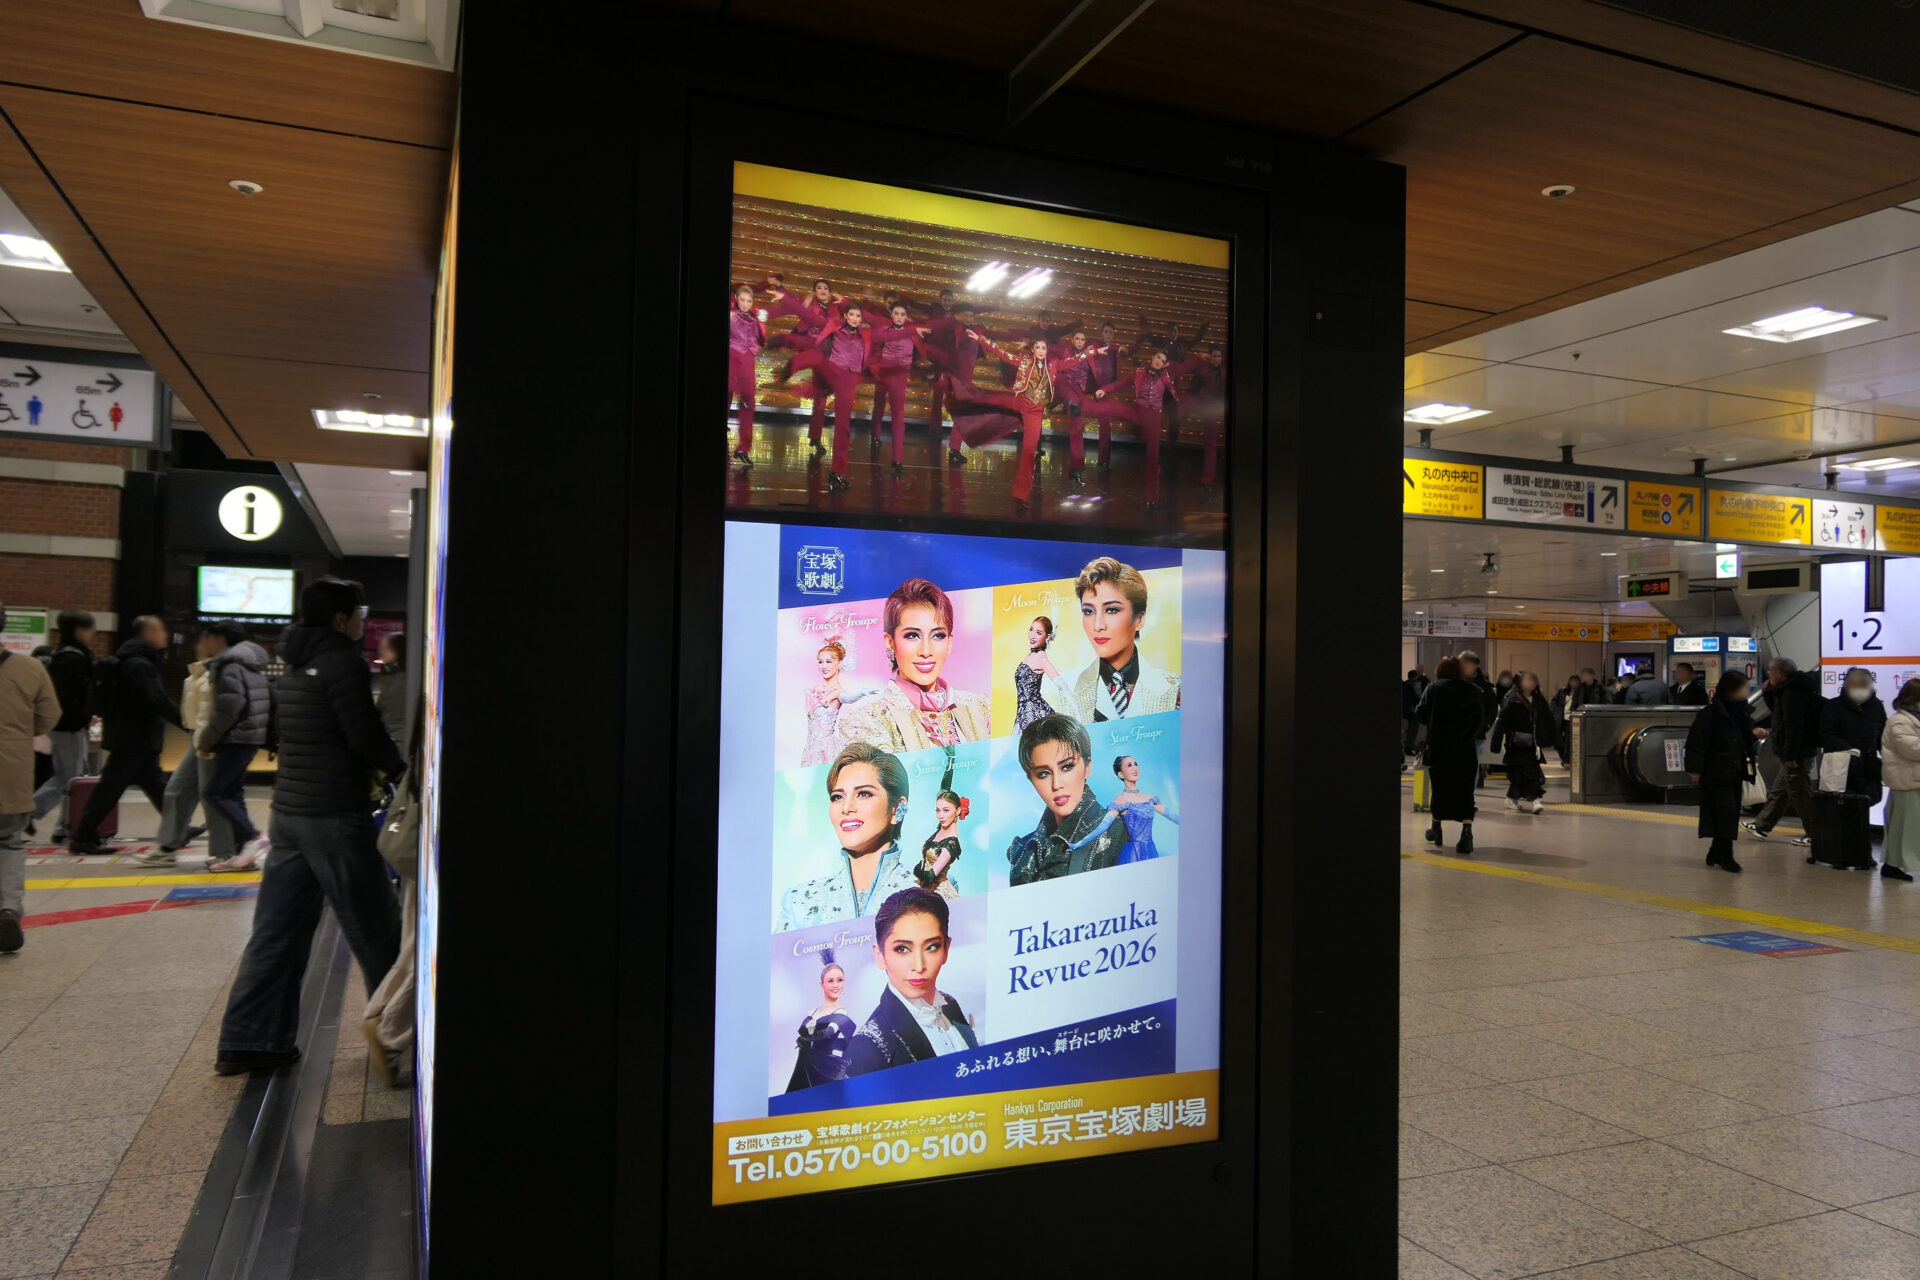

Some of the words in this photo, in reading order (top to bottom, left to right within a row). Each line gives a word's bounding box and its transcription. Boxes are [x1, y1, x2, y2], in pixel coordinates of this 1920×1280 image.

[1422, 466, 1479, 483] 丸の内中央口
[1002, 594, 1037, 612] Moon
[1038, 592, 1072, 607] Troupe
[799, 616, 840, 633] Flower
[840, 611, 878, 630] Troupe
[1109, 731, 1129, 745] Star
[1130, 726, 1163, 742] Troupe
[942, 755, 977, 771] Troupe
[1008, 901, 1158, 956] Takarazuka
[793, 939, 834, 957] Cosmos
[834, 931, 873, 948] Troupe
[1007, 959, 1091, 995] Revue
[1094, 932, 1158, 975] 2026
[955, 1016, 1162, 1078] あふれる想い、舞台に咲かせて。
[1003, 1102, 1035, 1117] Hankyu
[1037, 1096, 1083, 1114] Corporation
[816, 1109, 987, 1138] 宝塚歌劇インフォメーションセンター
[1003, 1097, 1208, 1151] 東京宝塚劇場
[735, 1133, 804, 1151] お問い合わせ
[727, 1130, 988, 1184] Tel.0570-00-5100
